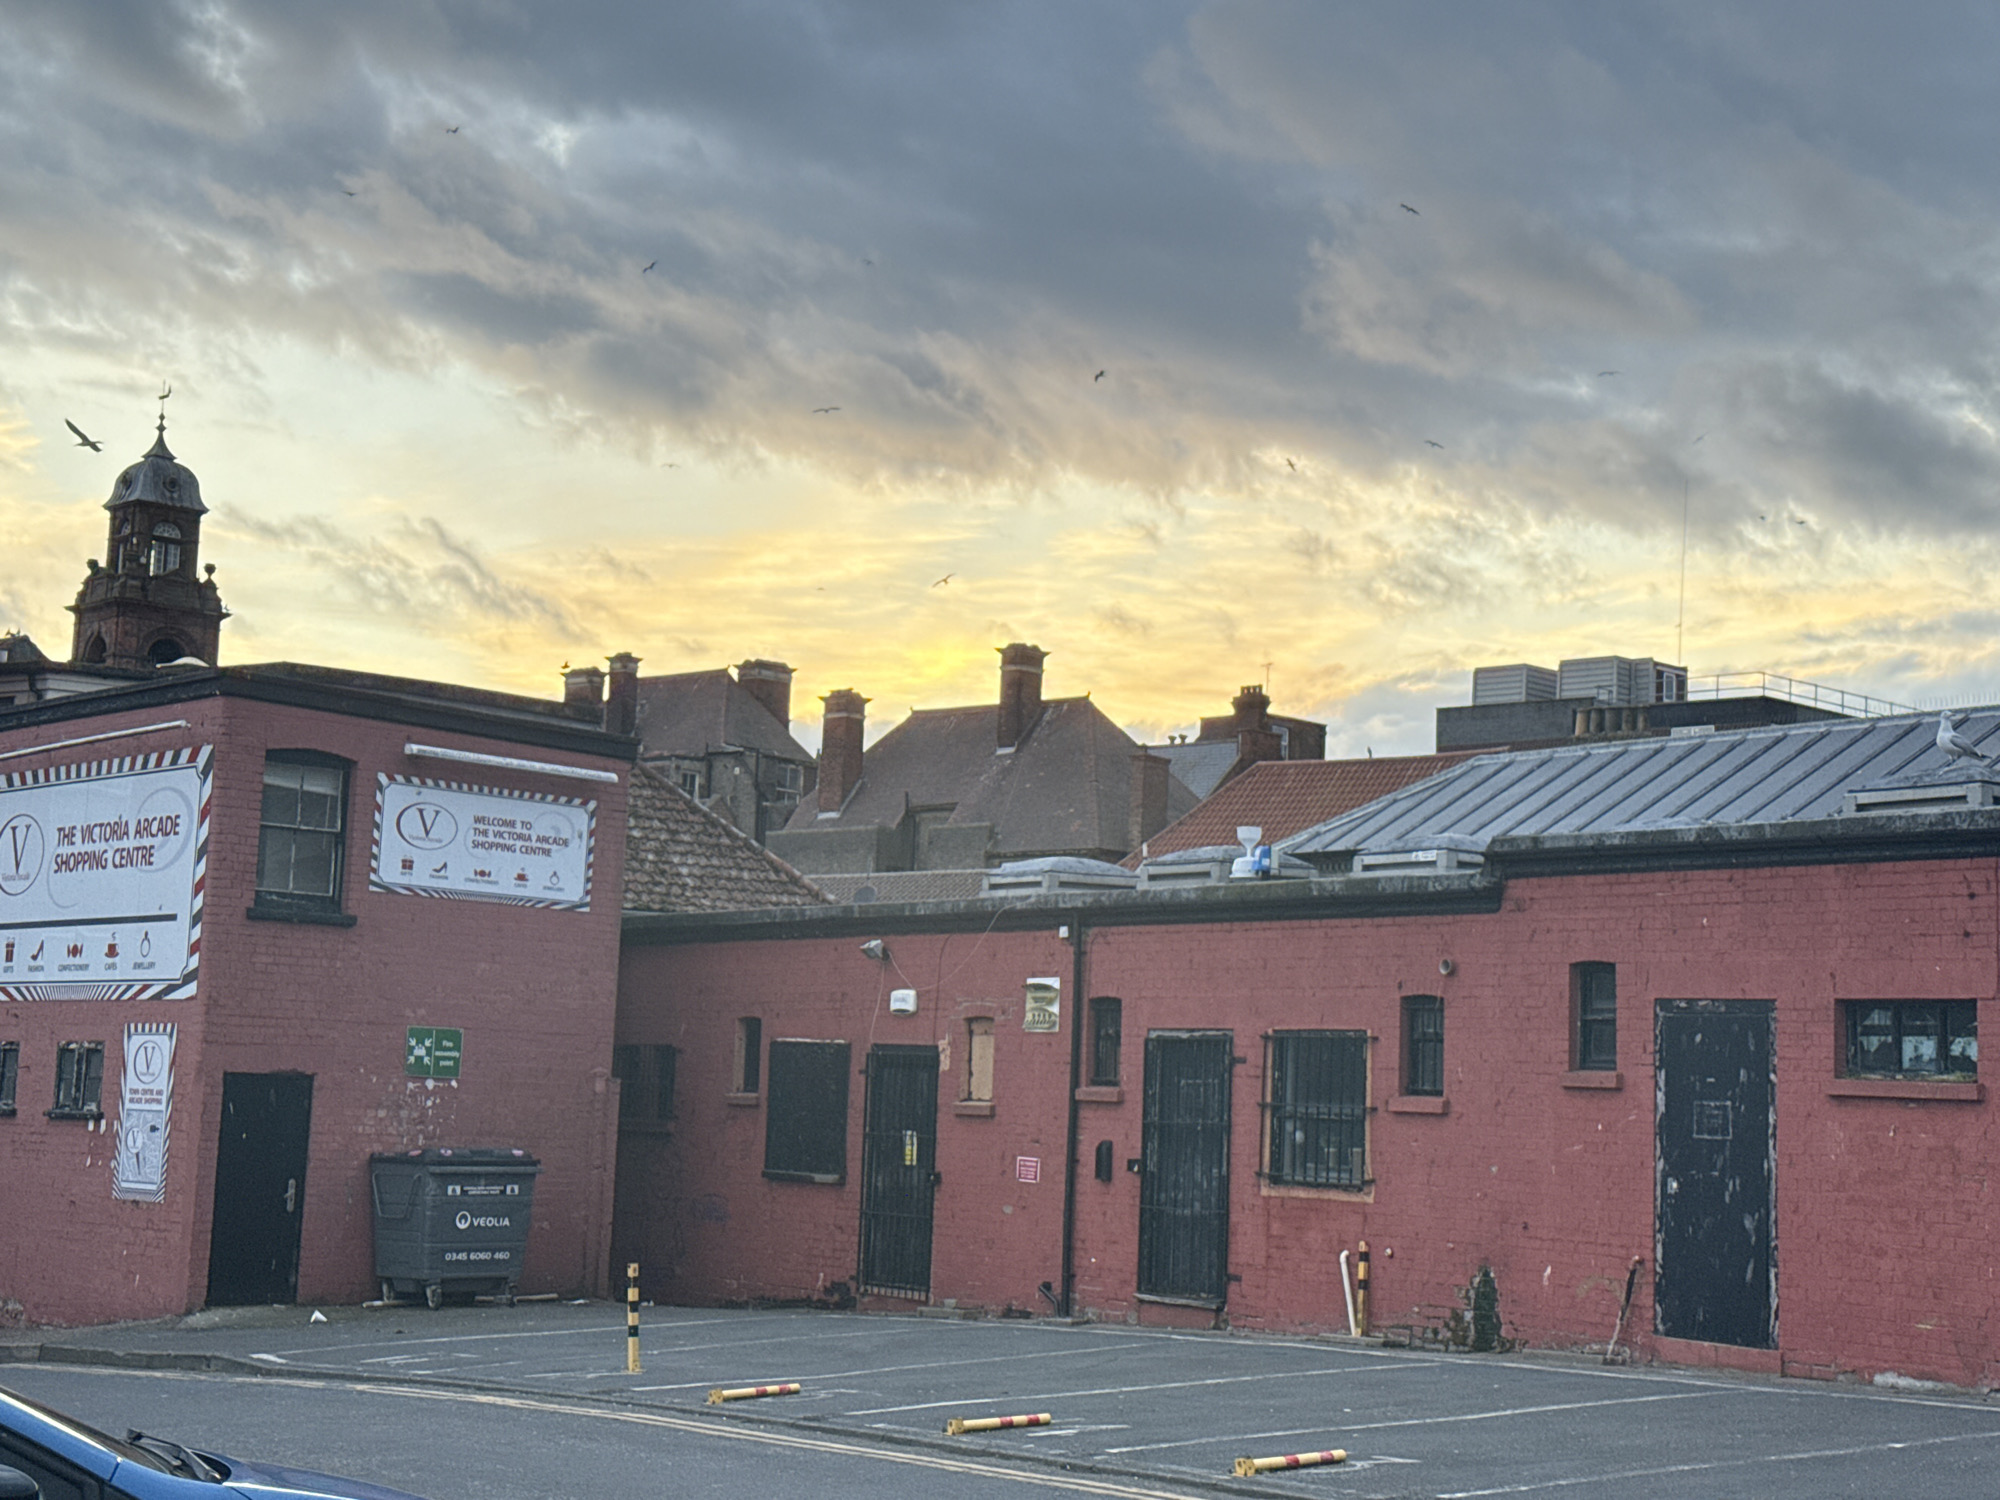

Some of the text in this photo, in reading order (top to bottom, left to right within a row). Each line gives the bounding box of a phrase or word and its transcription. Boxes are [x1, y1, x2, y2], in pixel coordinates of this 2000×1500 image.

[57, 814, 181, 847] THE VICTORIA ARCADE
[415, 807, 442, 838] V
[473, 815, 532, 831] WELCOME TO
[10, 824, 32, 874] V
[472, 827, 570, 848] THE VICTORIA ARCADE
[472, 840, 553, 858] SHOPPING CENTRE
[53, 845, 156, 875] SHOPPING CENTRE
[143, 1046, 156, 1073] V
[472, 1217, 511, 1228] VEOLIA
[445, 1251, 510, 1261] 0345 6060 460
